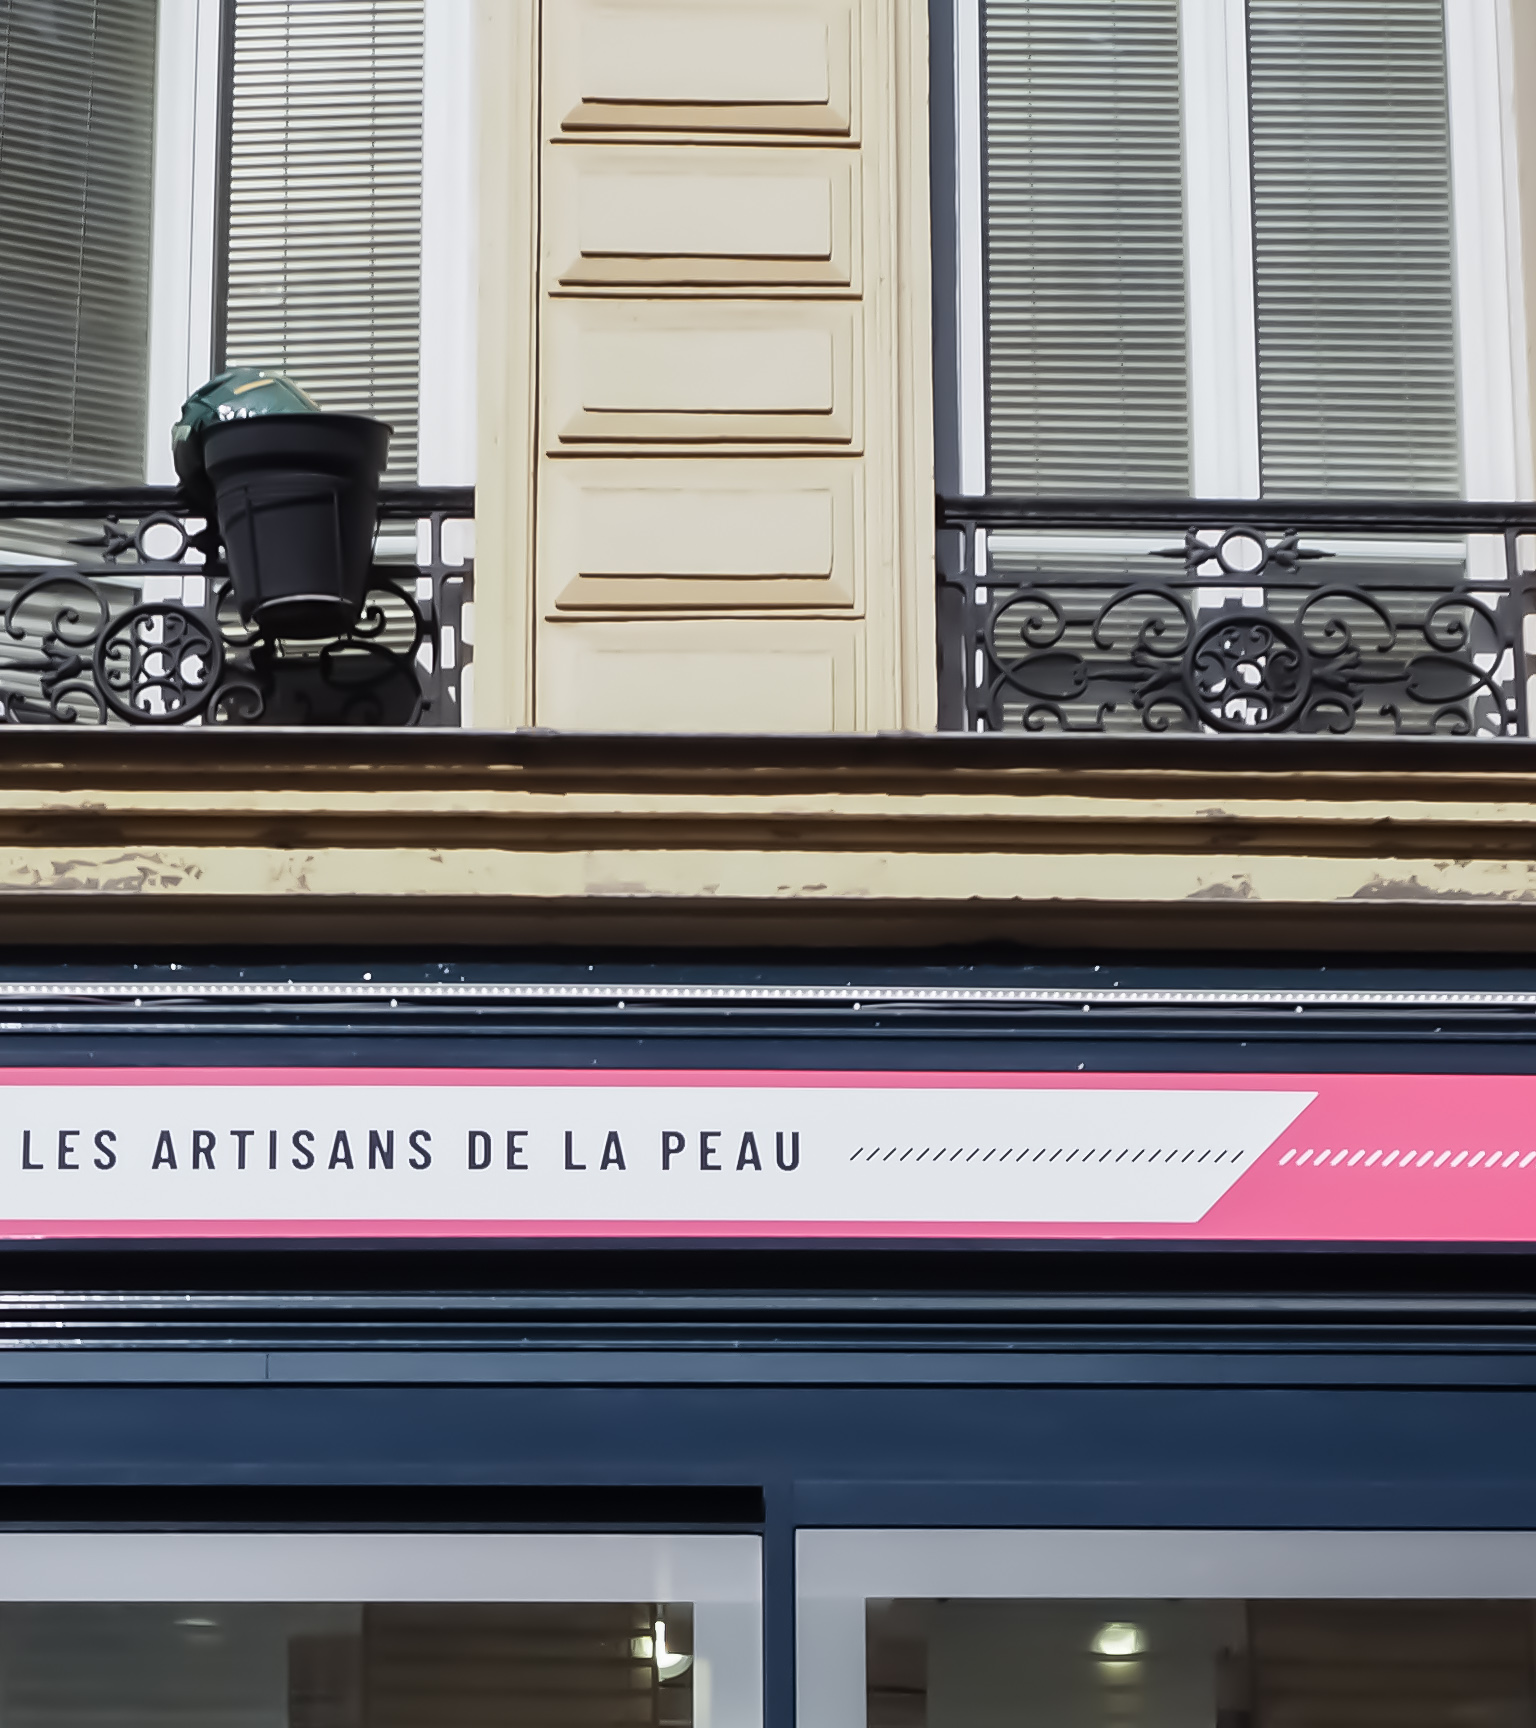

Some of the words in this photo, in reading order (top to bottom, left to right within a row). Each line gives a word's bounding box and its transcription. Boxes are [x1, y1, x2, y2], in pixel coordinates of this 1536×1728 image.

[21, 1129, 117, 1171] LES
[151, 1129, 432, 1171] ARTISANS
[467, 1130, 529, 1171] DE
[564, 1130, 627, 1171] LA
[661, 1130, 801, 1172] PEAU
